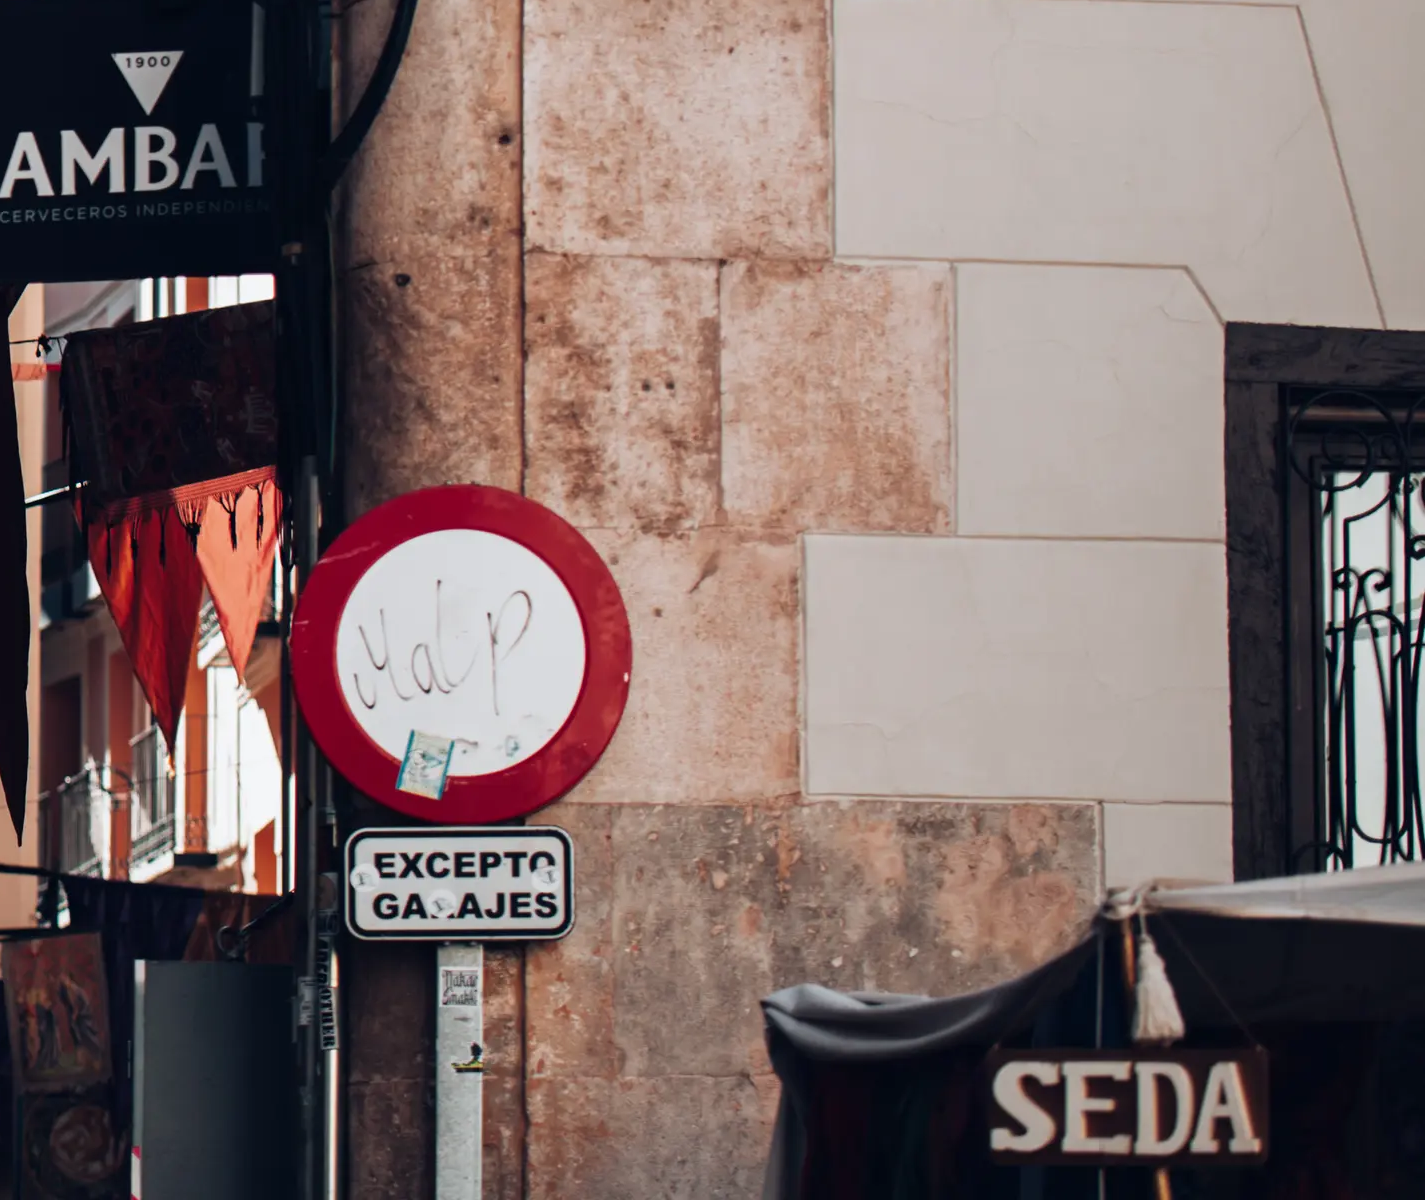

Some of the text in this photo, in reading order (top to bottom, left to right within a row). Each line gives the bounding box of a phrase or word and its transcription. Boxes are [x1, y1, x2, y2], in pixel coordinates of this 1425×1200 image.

[125, 55, 171, 70] 1900
[0, 204, 128, 224] CERVECEROS
[373, 851, 556, 879] EXCEPTO
[372, 893, 558, 920] GAAJES
[989, 1059, 1262, 1156] SEDA
